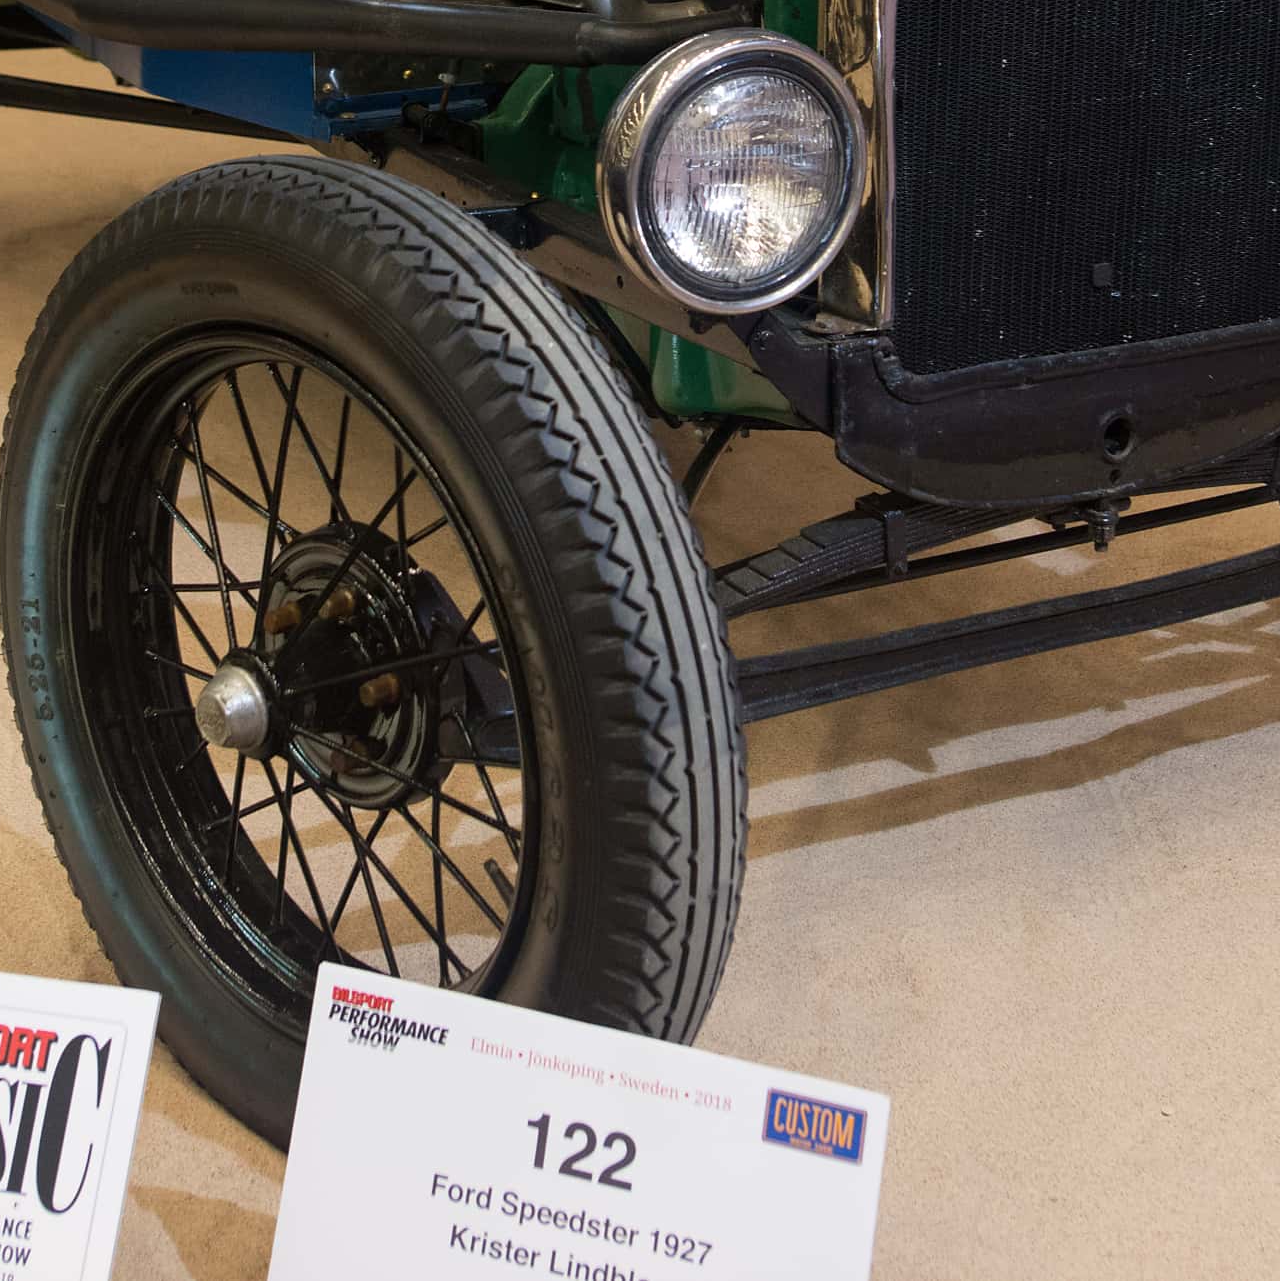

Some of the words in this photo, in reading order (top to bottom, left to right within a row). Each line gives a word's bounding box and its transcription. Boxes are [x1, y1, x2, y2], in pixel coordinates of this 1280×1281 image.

[328, 1003, 450, 1046] PERFORMANCE
[349, 1025, 401, 1050] SHOW
[471, 1036, 514, 1061] Elmia
[619, 1071, 680, 1101] Sweden
[694, 1090, 734, 1112] 2018
[527, 1112, 638, 1192] 122
[773, 1096, 856, 1151] CUSTOM
[431, 1172, 493, 1210] Ford
[500, 1191, 640, 1247] Speedster
[650, 1230, 713, 1266] 1927
[449, 1223, 542, 1269] Krister
[549, 1250, 650, 1281] Lindbl
